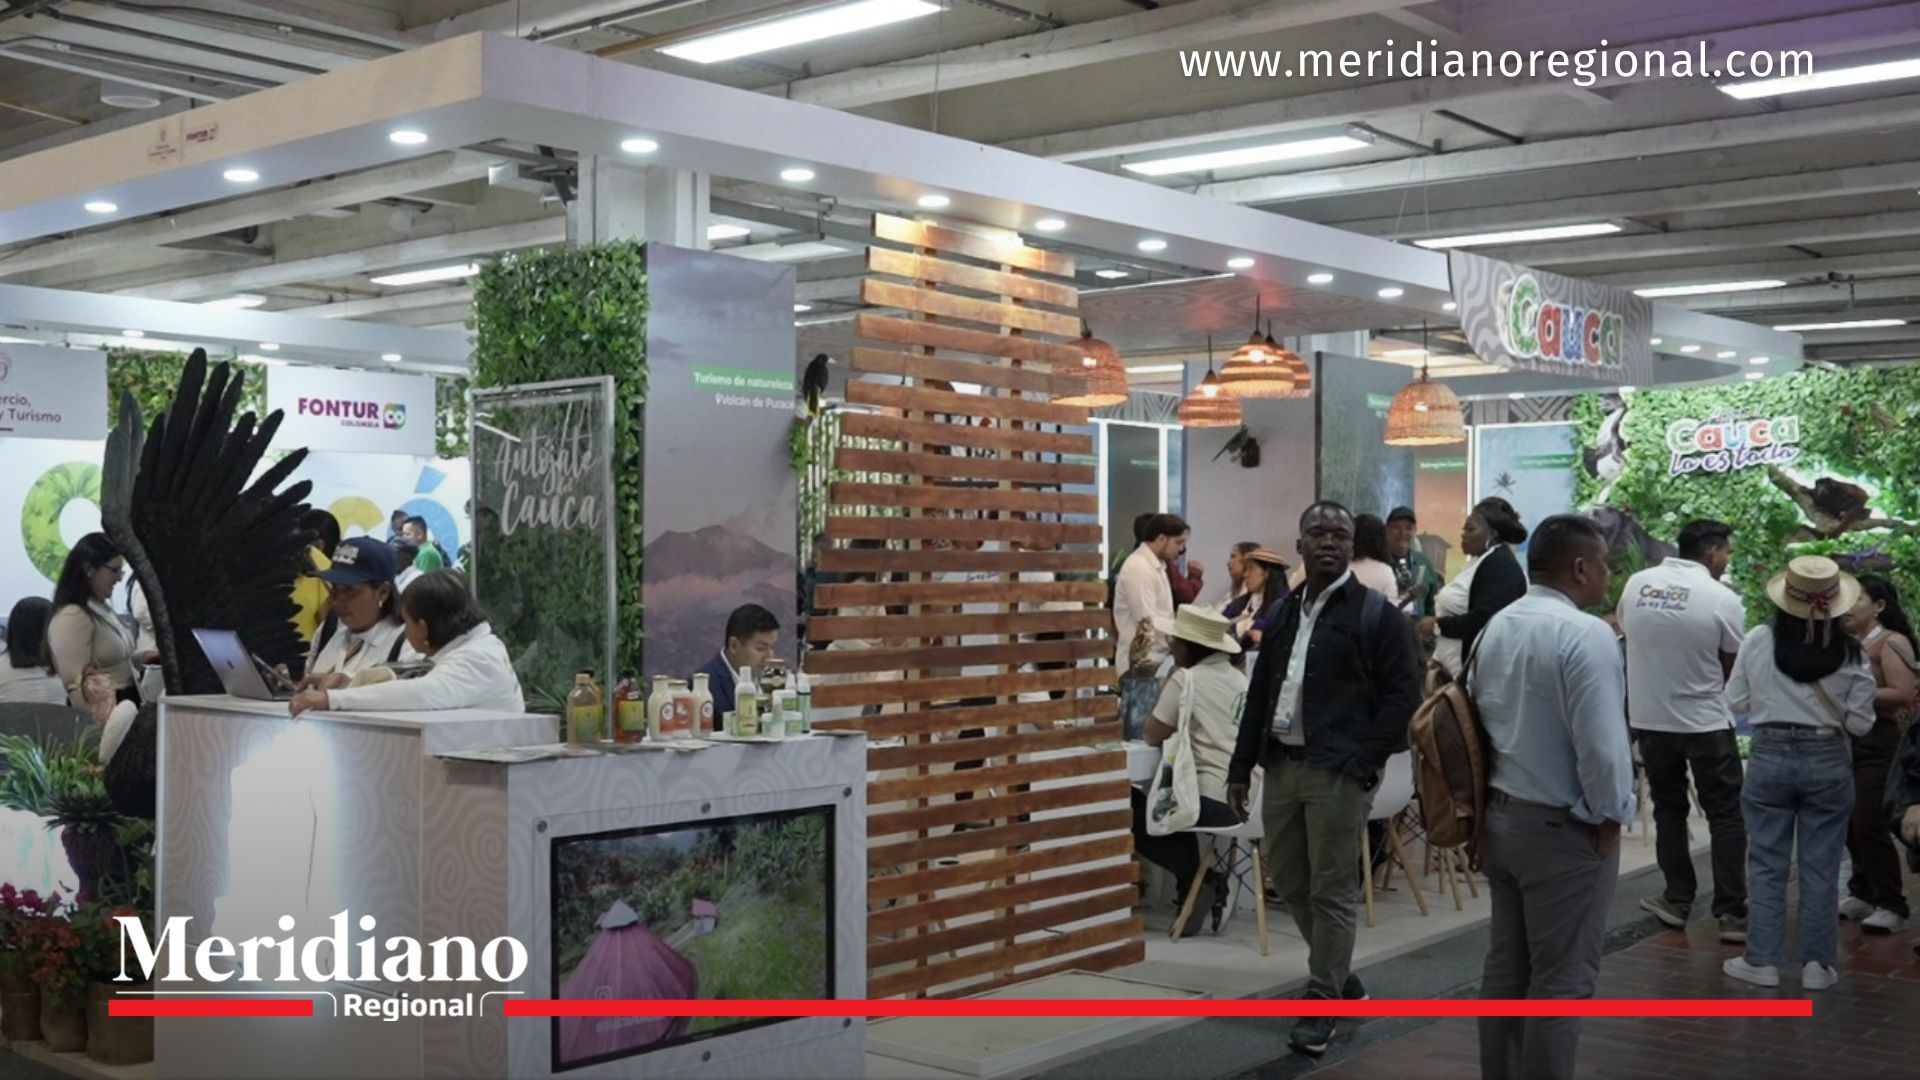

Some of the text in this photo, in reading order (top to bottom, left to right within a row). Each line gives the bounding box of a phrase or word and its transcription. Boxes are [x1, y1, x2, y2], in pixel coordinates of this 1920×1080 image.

[1508, 272, 1624, 370] Cauca
[693, 372, 794, 391] Turismo de naturaleza
[0, 394, 31, 407] rcio,
[298, 397, 379, 420] FONTUR
[752, 397, 764, 407] de
[8, 408, 62, 423] Turismo
[1667, 414, 1799, 453] Cauca
[1702, 449, 1730, 472] es
[1733, 442, 1799, 470] todo
[501, 480, 602, 536] Cauca
[1640, 584, 1689, 602] Cauca
